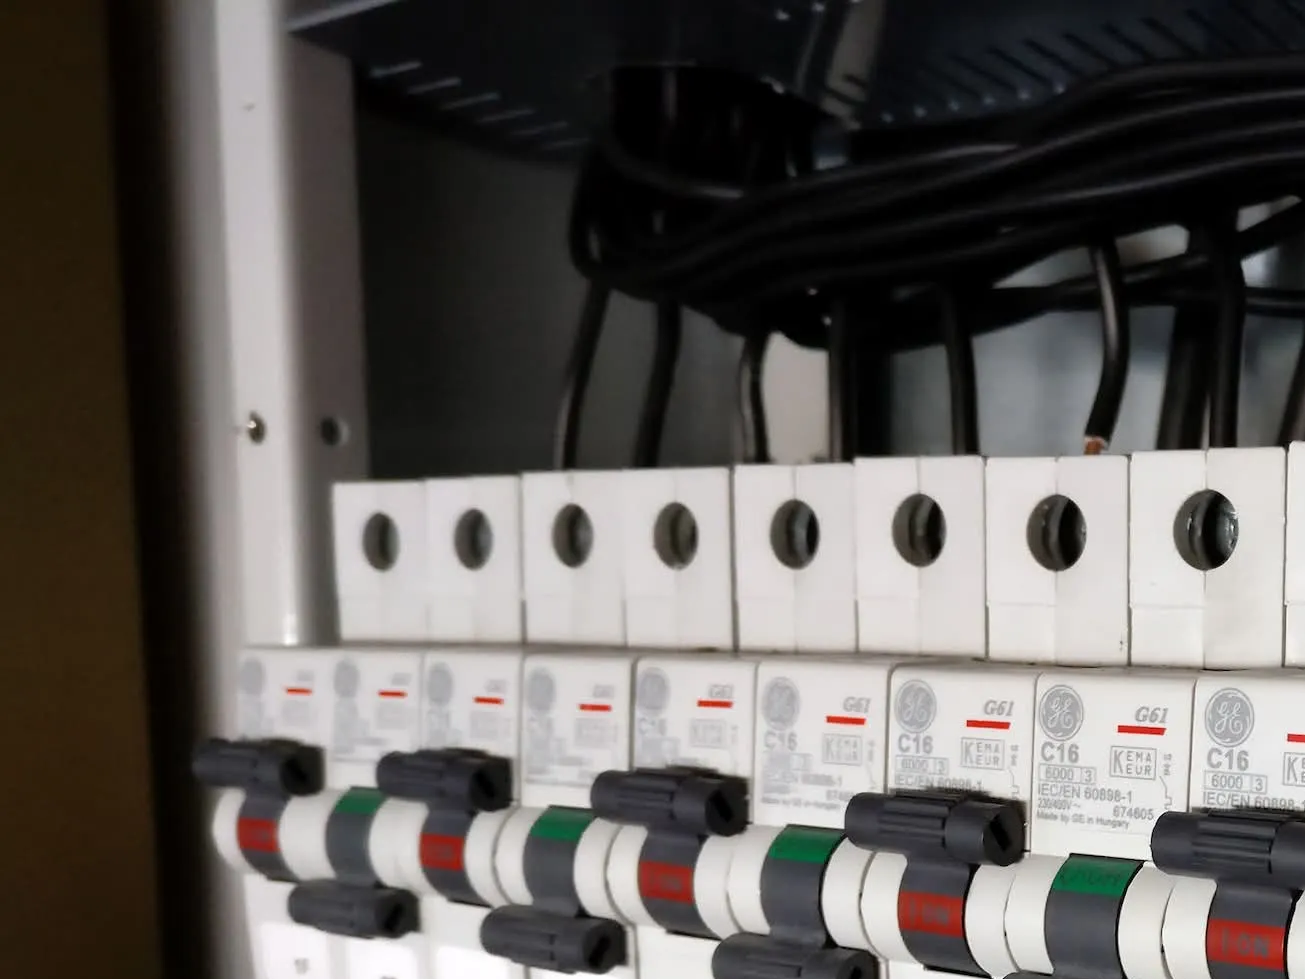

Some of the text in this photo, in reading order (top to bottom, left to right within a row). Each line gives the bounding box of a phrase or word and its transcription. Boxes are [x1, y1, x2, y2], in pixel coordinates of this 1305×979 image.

[1135, 706, 1169, 724] G61
[764, 730, 797, 751] C16
[898, 733, 934, 755] C16
[1041, 741, 1080, 763] C16
[1207, 748, 1249, 771] C16
[1038, 783, 1081, 799] IEC/EN
[1211, 774, 1243, 790] 6000
[1203, 791, 1250, 808] IEC/EN
